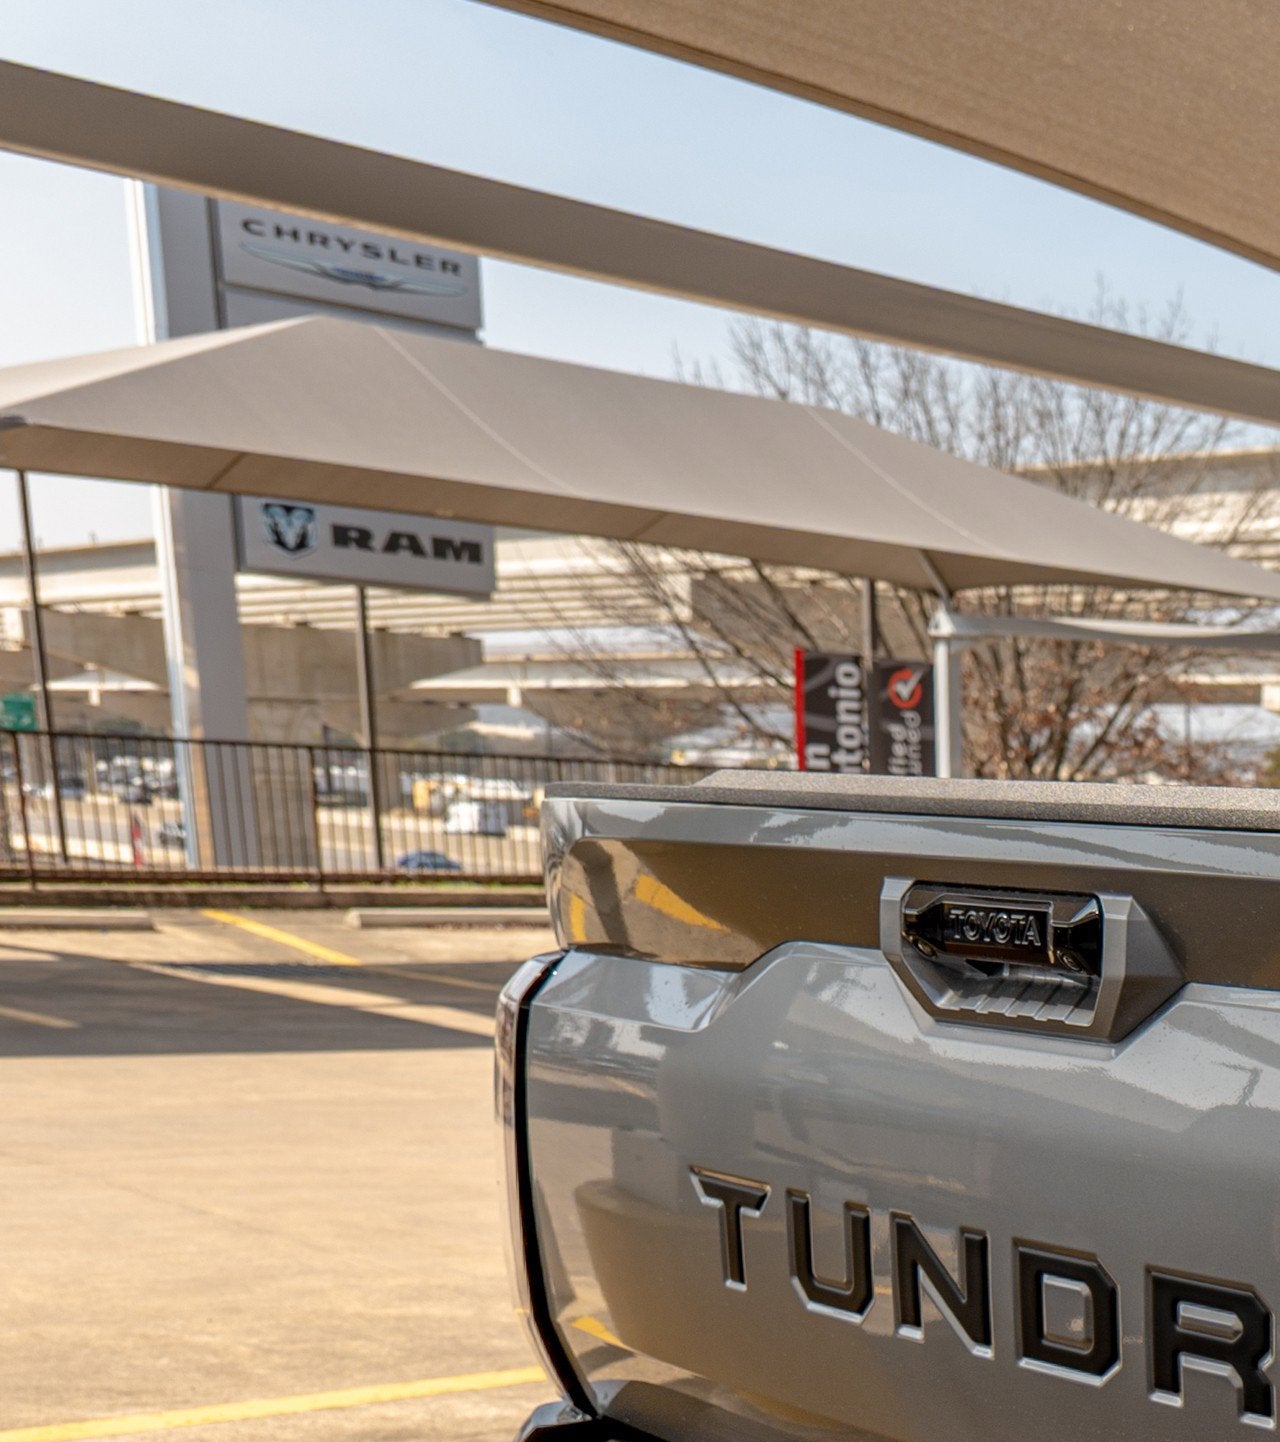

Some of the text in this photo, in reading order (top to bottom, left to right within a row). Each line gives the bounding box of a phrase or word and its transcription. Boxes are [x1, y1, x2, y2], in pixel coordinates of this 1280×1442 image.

[241, 218, 463, 277] CHRYSLER
[331, 523, 484, 566] RAM
[827, 662, 863, 773] tonio
[948, 909, 1041, 946] TOYOTA
